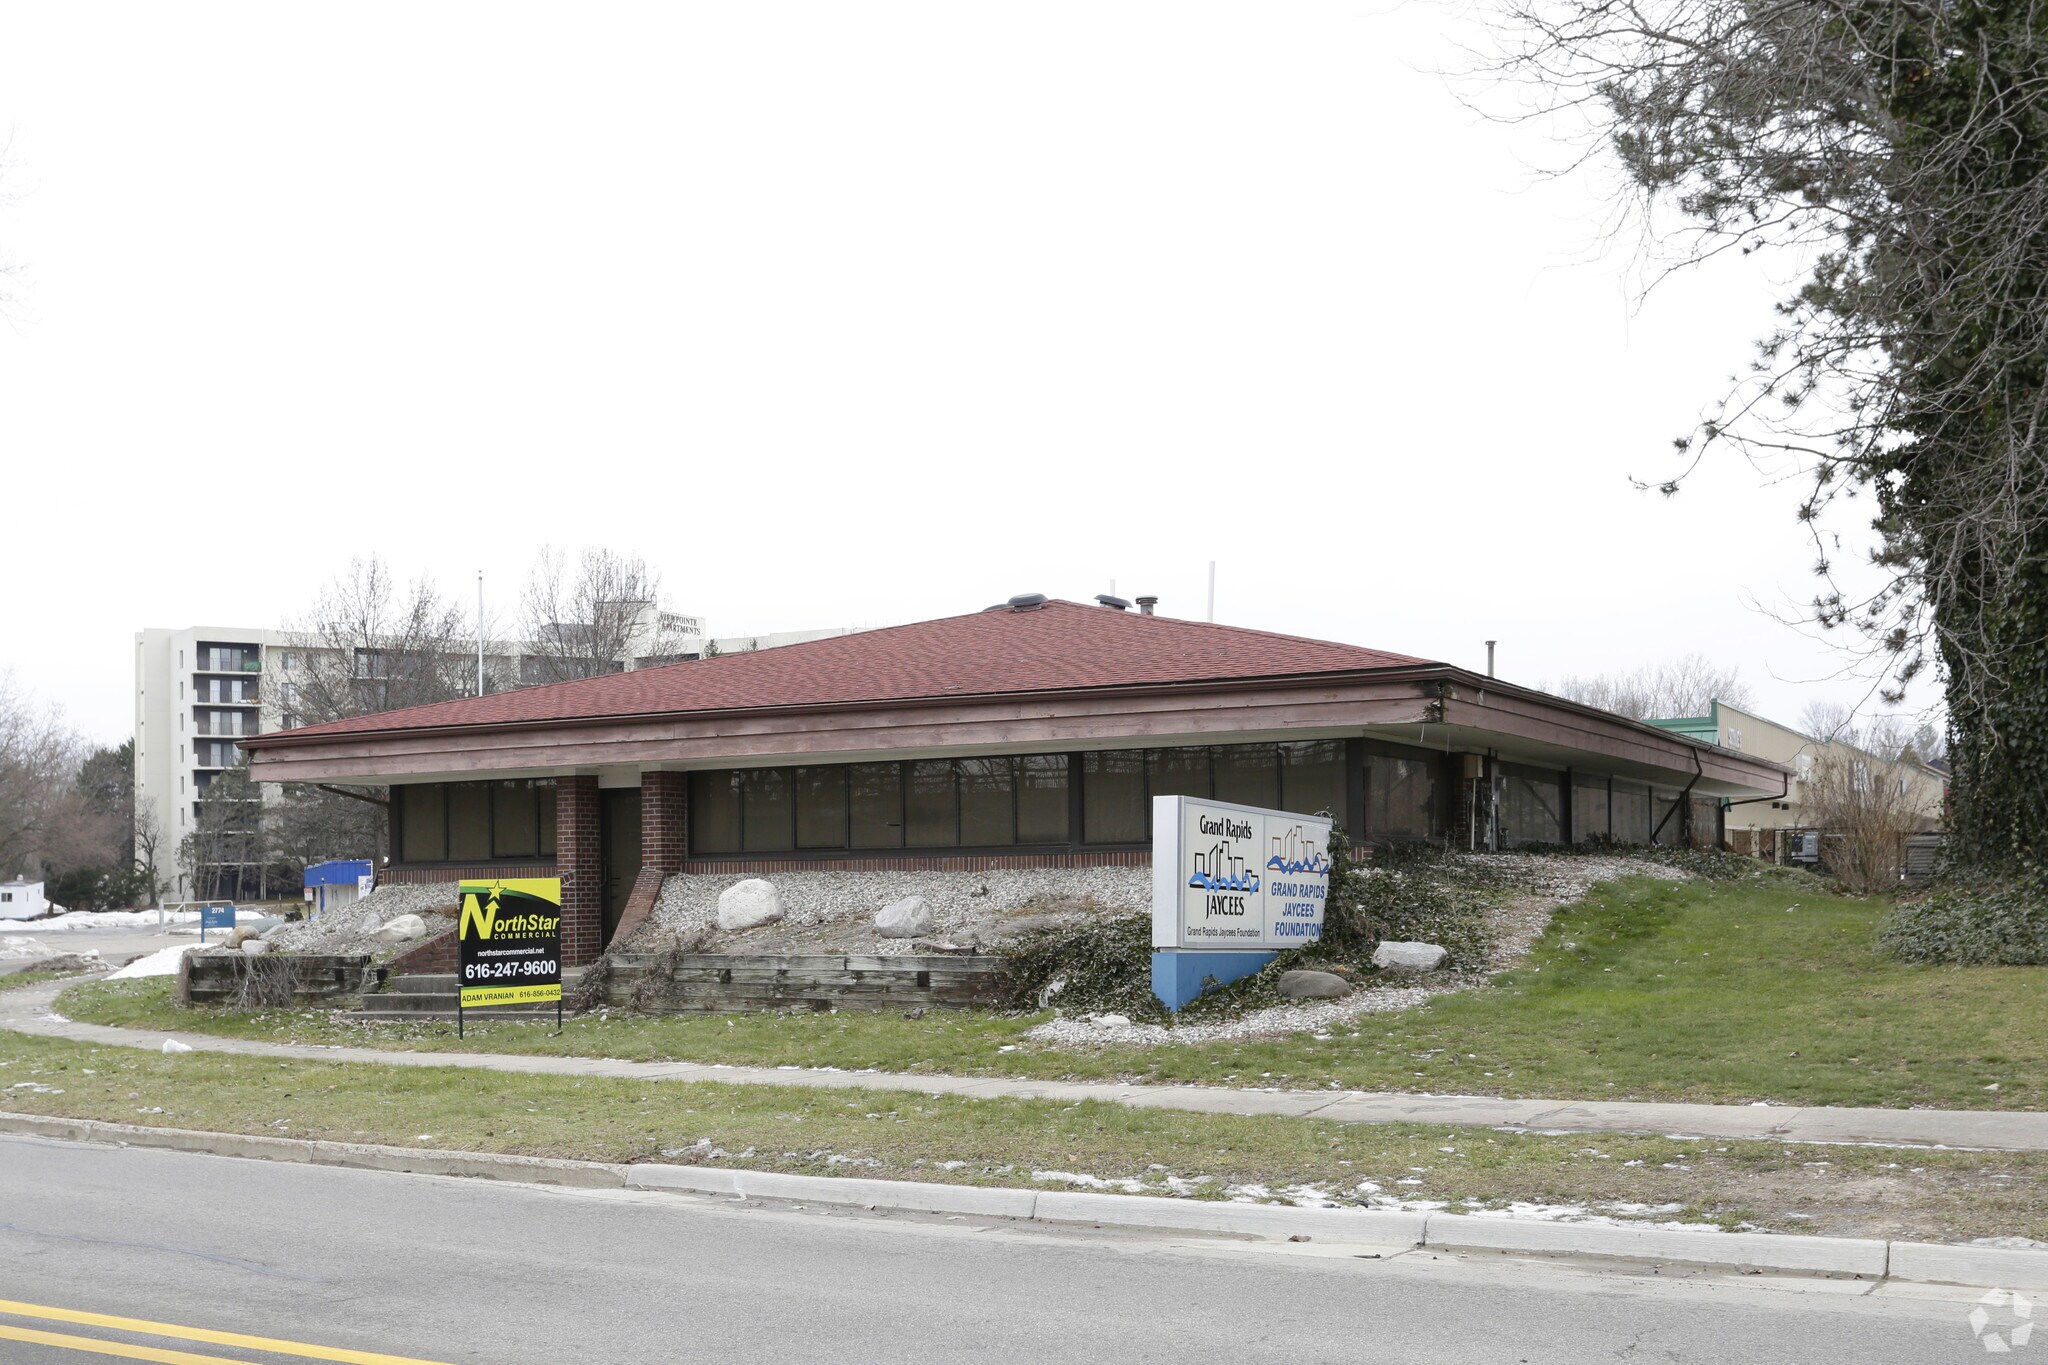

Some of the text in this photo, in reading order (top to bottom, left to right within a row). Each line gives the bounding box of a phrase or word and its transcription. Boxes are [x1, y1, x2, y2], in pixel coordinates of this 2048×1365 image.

[661, 622, 701, 635] APARTMENTS
[1200, 815, 1252, 843] Grand Rapids
[1271, 882, 1325, 899] GRAND RAPIDS
[1206, 895, 1245, 919] JAYCEES
[1282, 902, 1315, 918] JAYCEES
[459, 893, 560, 940] NorthStar
[494, 931, 556, 940] COMMERCIAL
[1187, 926, 1260, 938] Grand Rapids Jaycees Foundation
[1275, 922, 1323, 937] FOUNDATION
[477, 947, 545, 957] northstarcommercial.net
[465, 960, 557, 979] 616-247-9600
[462, 989, 561, 1002] ADAM VRANIAN 616-856-0432
